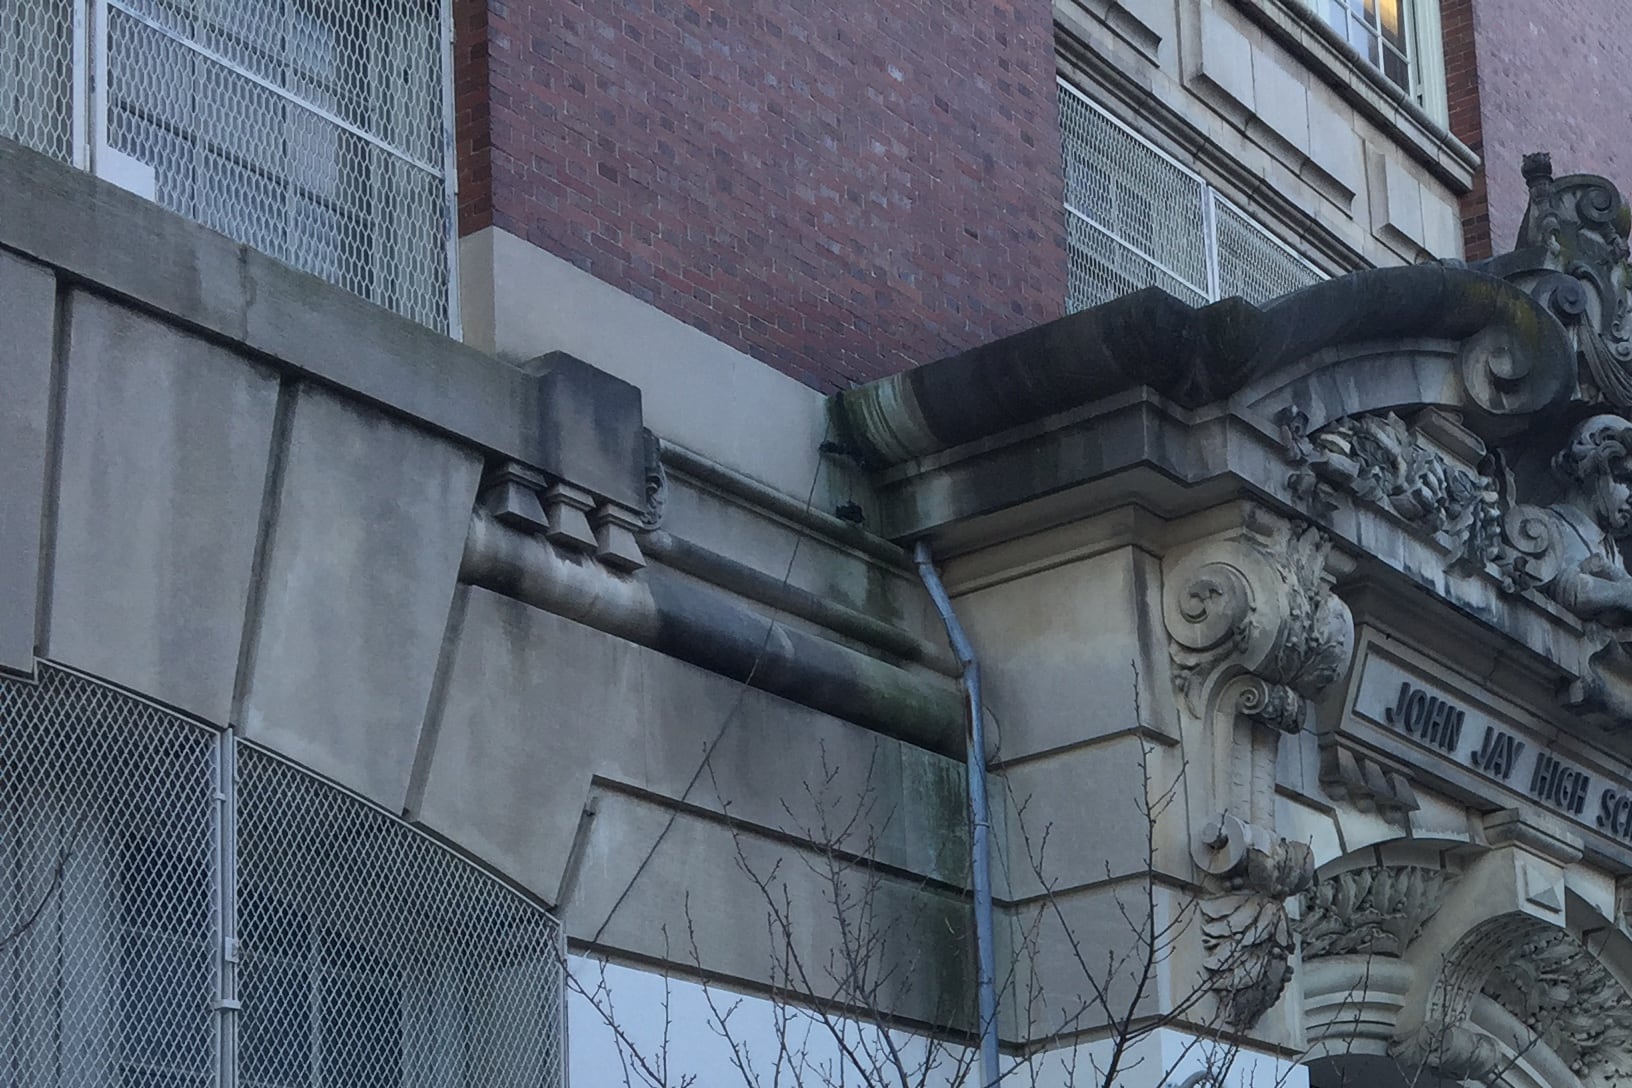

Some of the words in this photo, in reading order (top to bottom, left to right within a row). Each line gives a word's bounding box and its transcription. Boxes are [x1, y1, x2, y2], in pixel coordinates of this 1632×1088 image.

[1385, 682, 1466, 752] JOHN
[1471, 726, 1526, 780] JAY
[1530, 752, 1591, 815] HIGH
